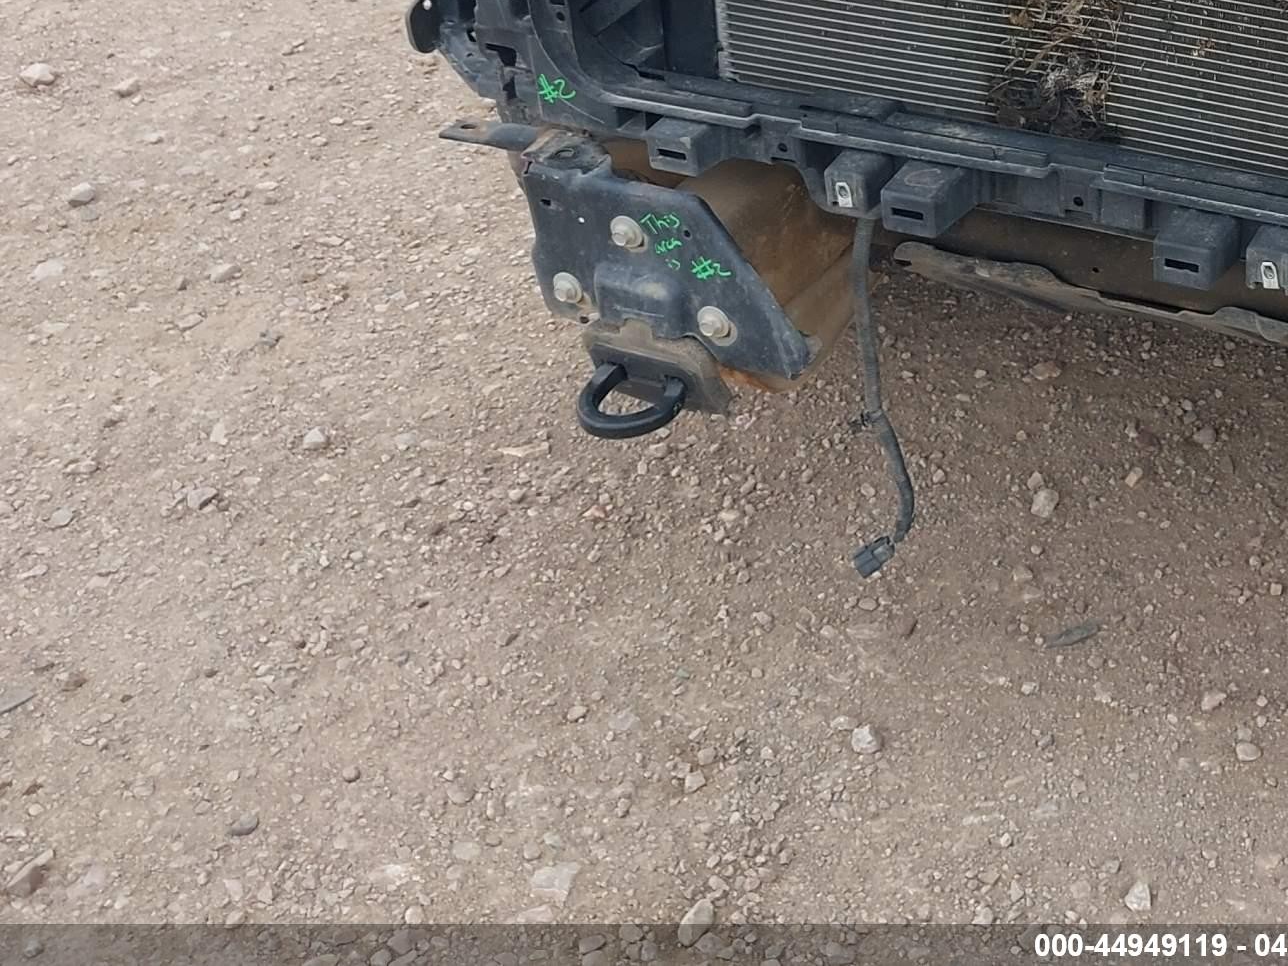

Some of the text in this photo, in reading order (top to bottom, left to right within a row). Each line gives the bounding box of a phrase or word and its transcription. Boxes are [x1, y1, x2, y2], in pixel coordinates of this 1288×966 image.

[537, 74, 576, 103] #2
[640, 213, 681, 234] This
[691, 256, 732, 280] #2
